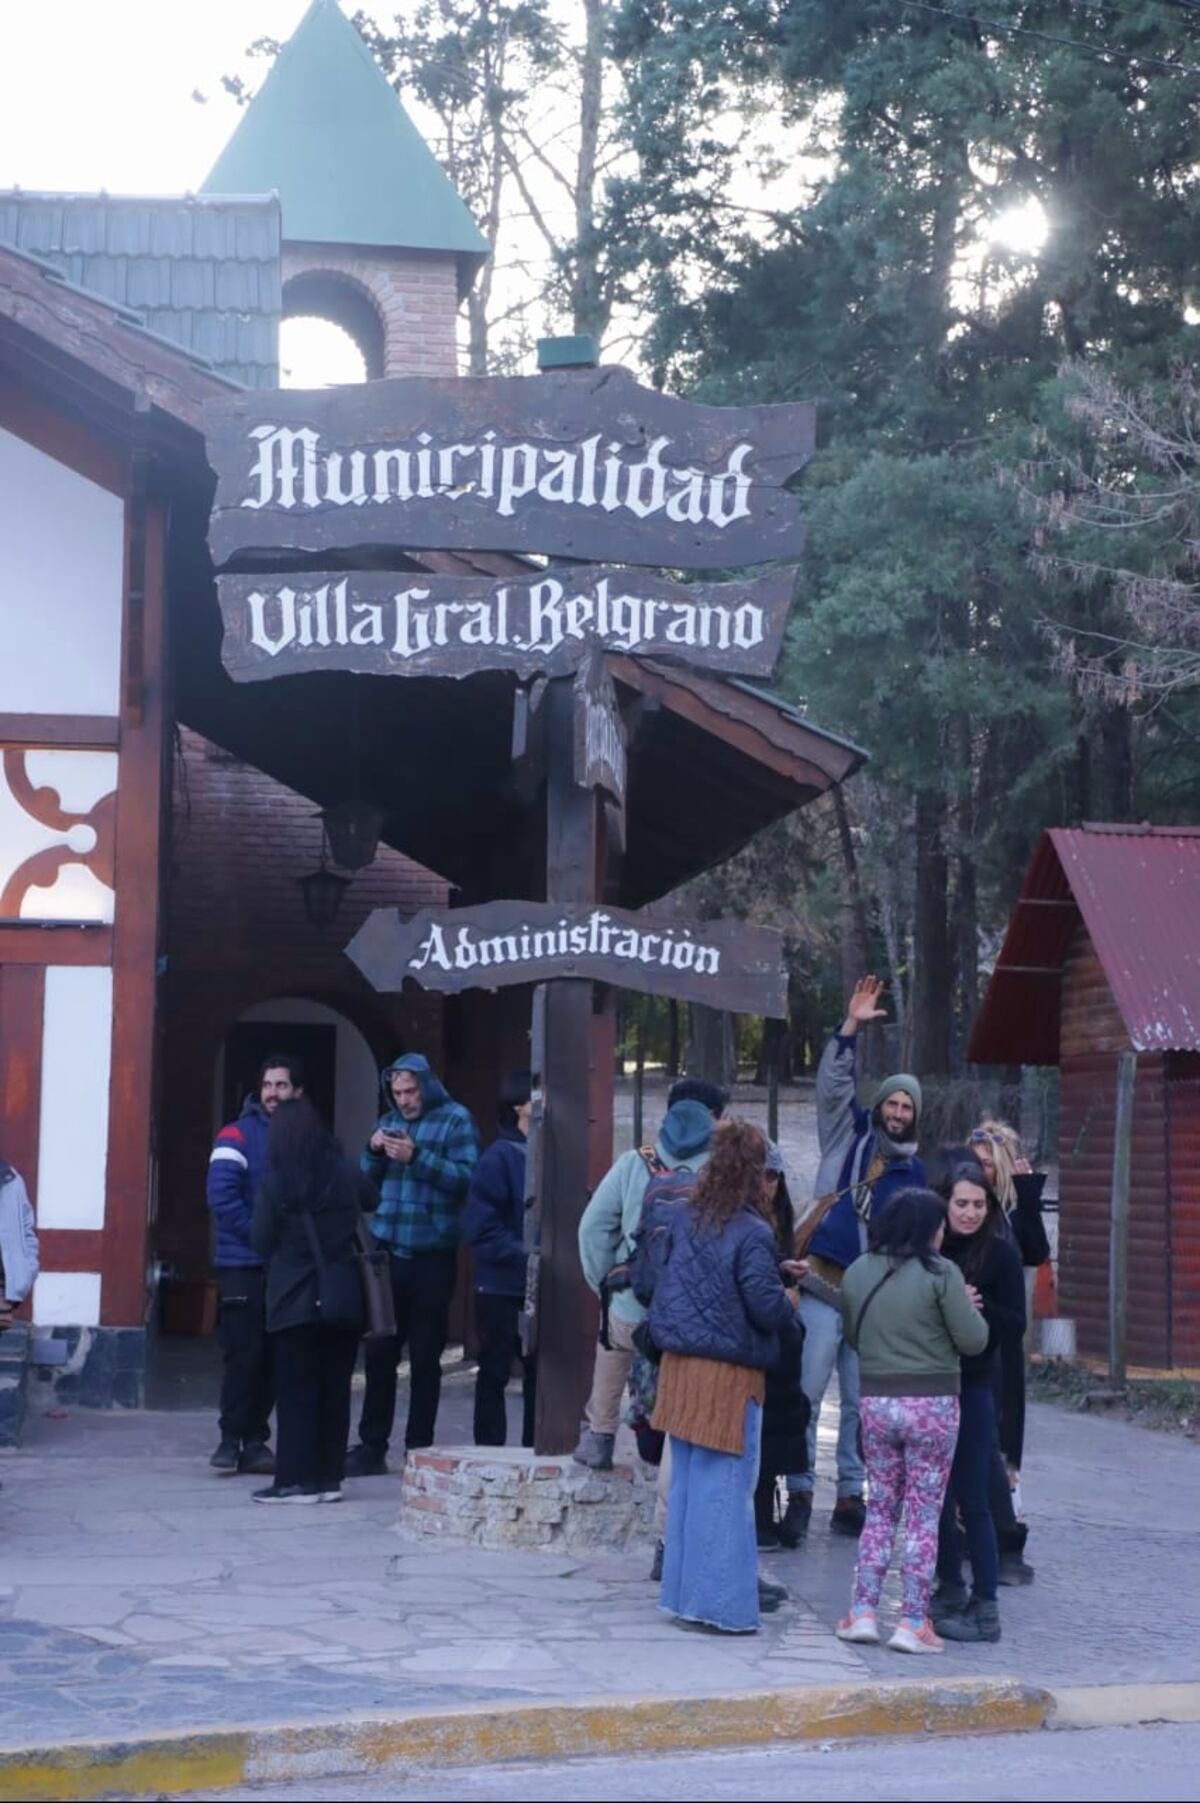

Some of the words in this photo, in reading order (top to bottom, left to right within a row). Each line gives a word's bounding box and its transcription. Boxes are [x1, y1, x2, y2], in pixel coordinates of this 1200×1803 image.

[241, 425, 753, 528] Municipalidad
[248, 578, 384, 656] Villa
[515, 578, 764, 653] Belgrano
